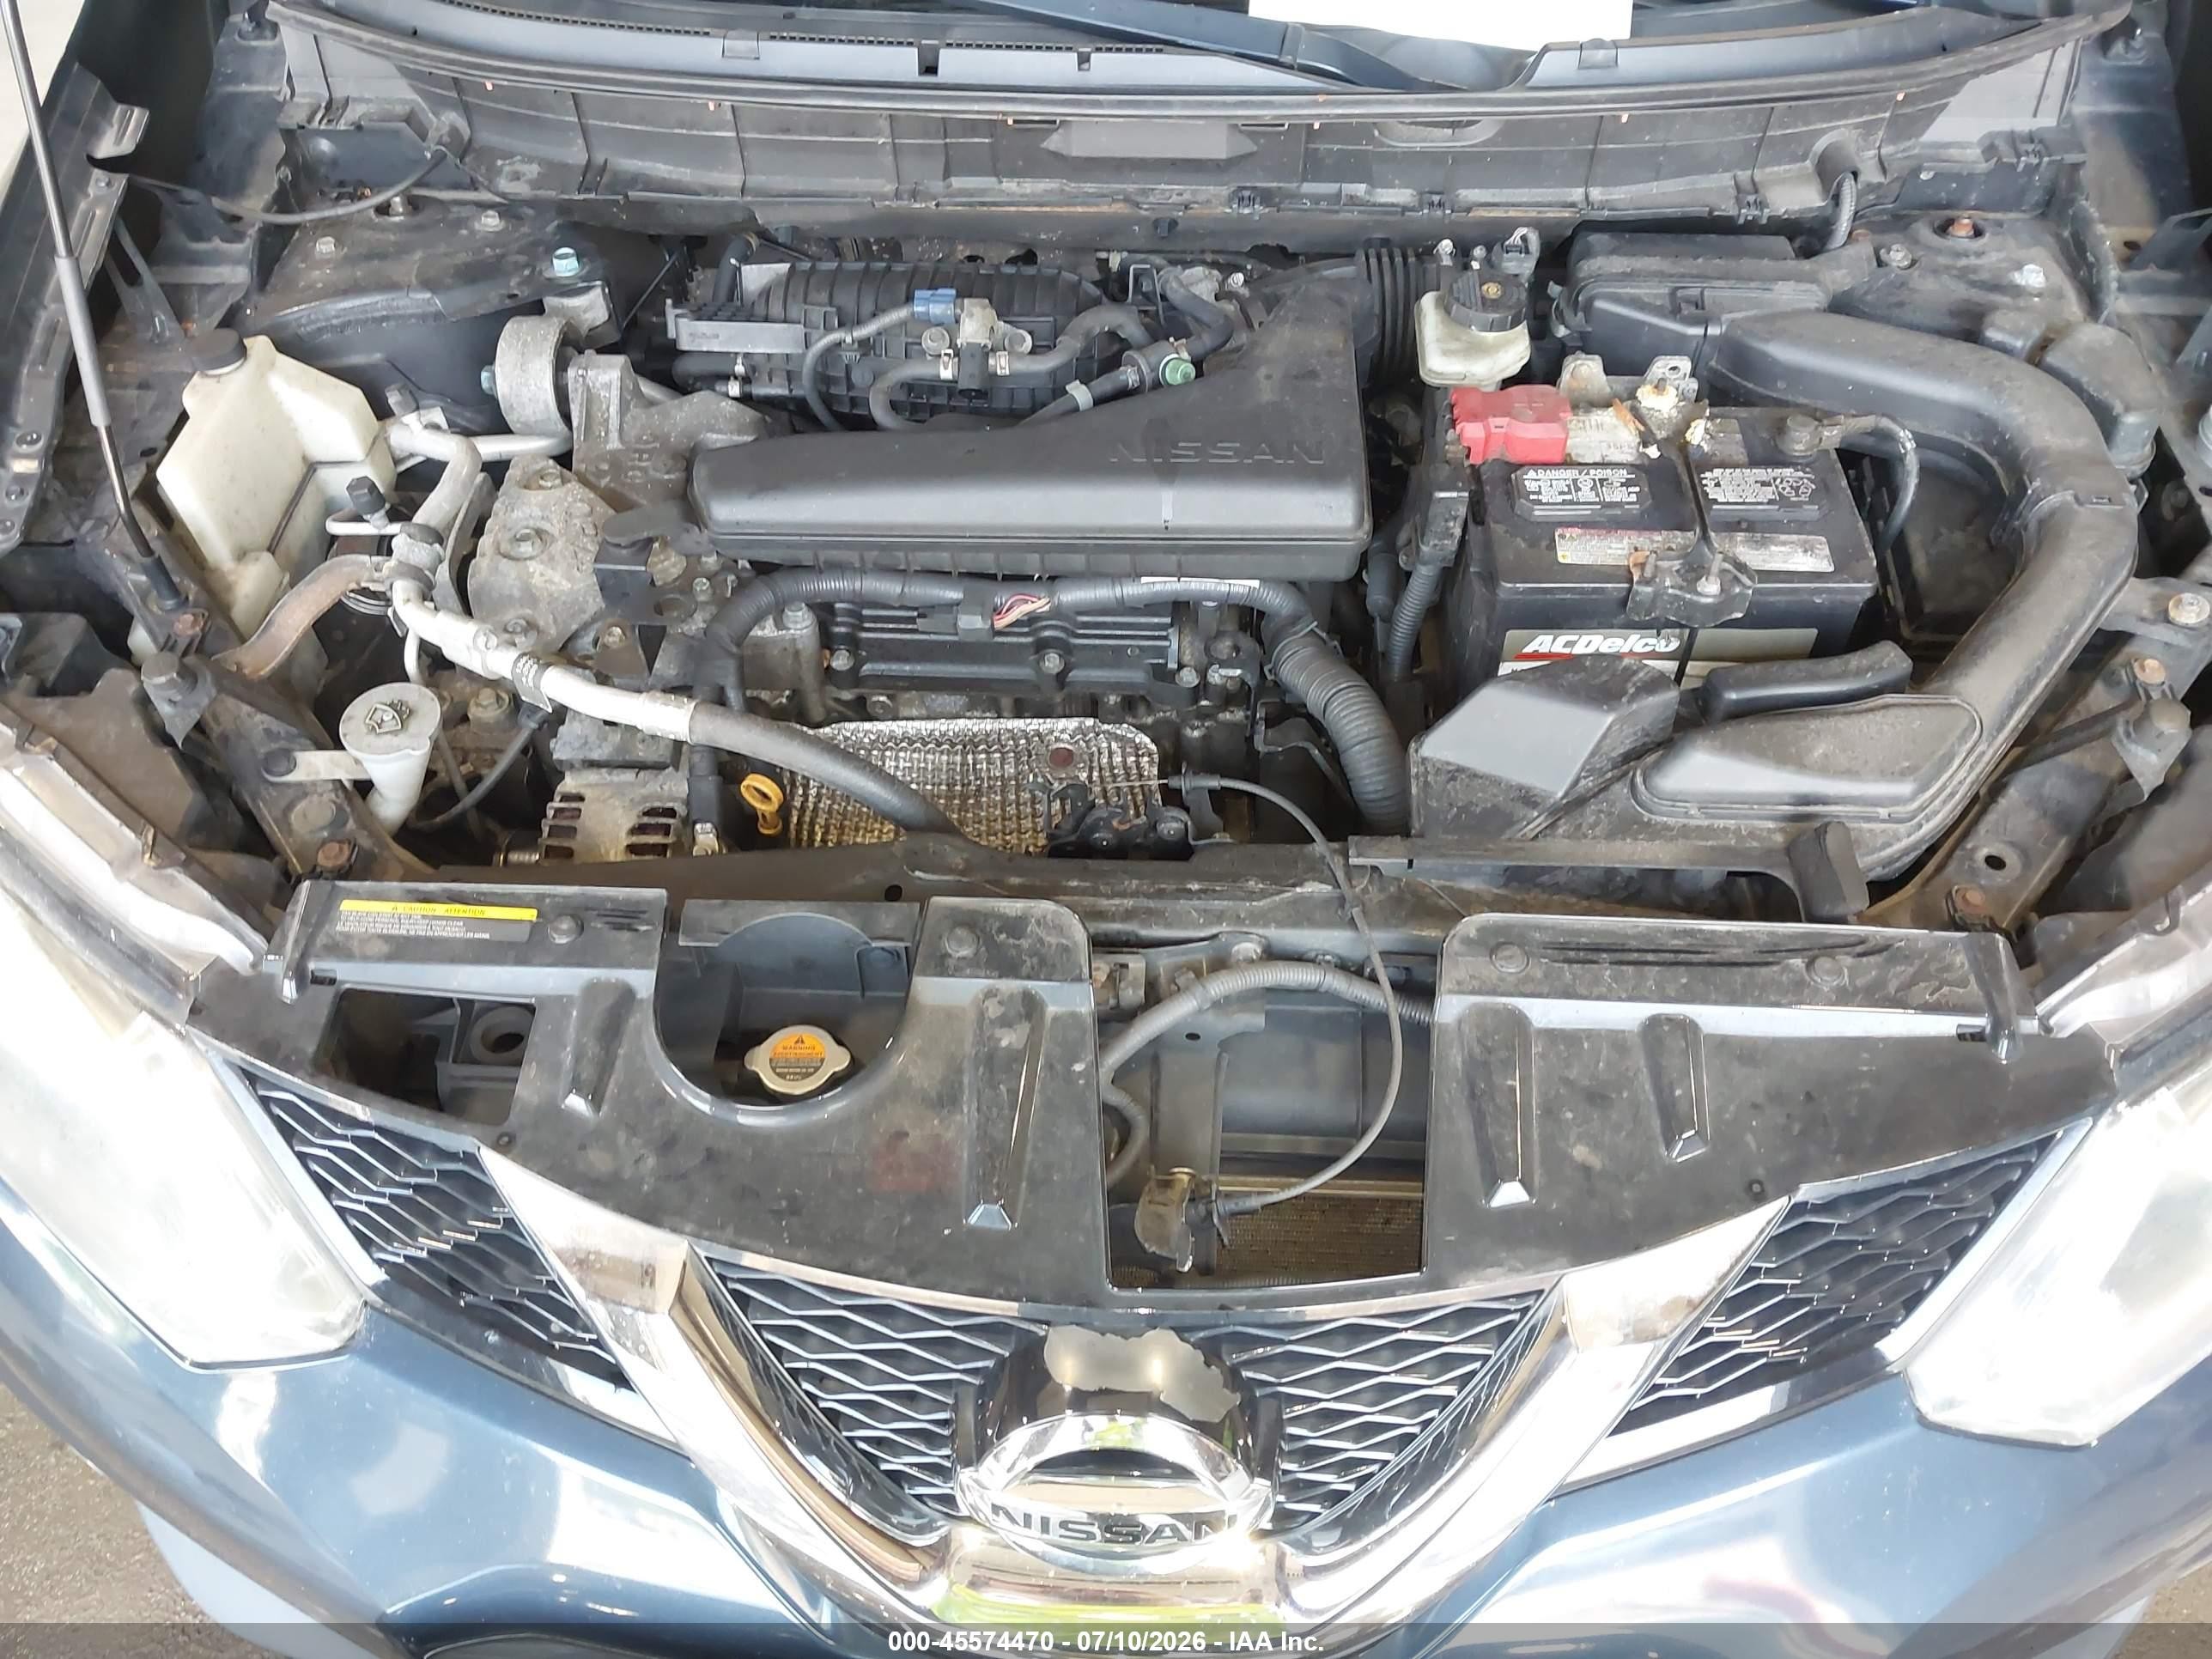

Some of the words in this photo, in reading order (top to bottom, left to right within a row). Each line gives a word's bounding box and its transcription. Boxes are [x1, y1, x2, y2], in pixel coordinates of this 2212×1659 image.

[1109, 442, 1324, 465] NISSAN
[1521, 634, 1680, 654] ACDelco
[991, 1503, 1239, 1545] NISSAN
